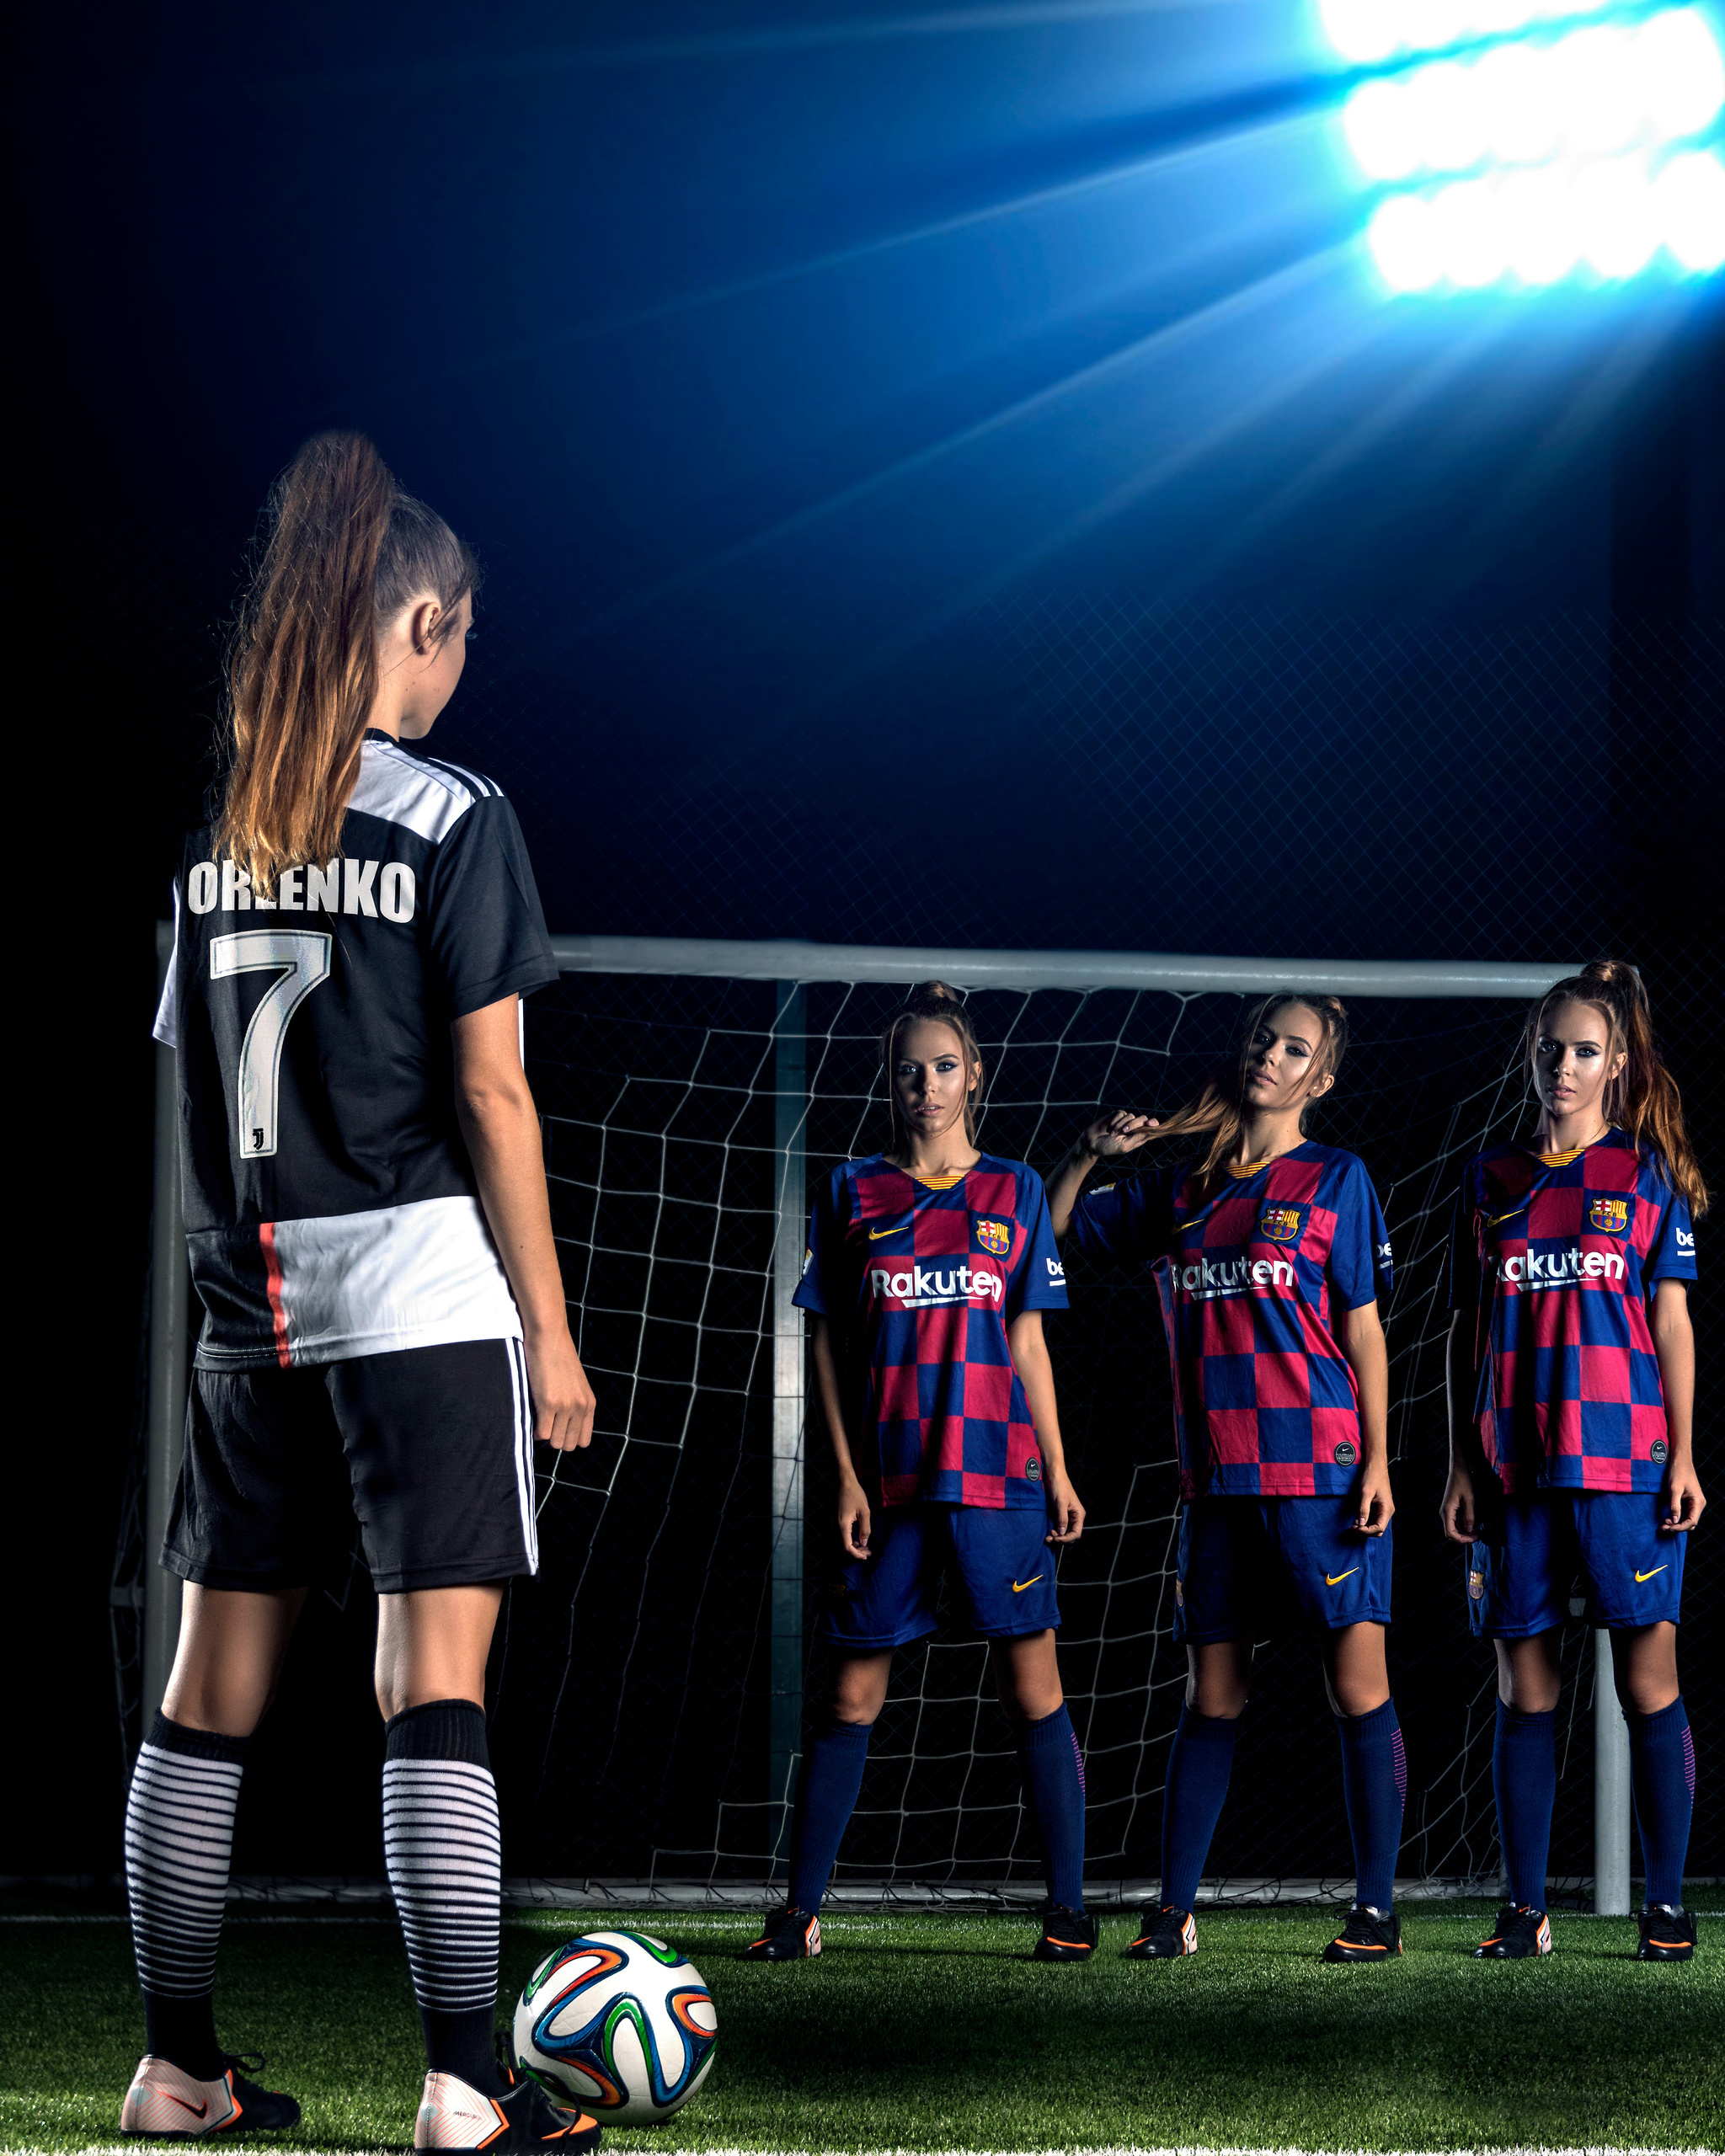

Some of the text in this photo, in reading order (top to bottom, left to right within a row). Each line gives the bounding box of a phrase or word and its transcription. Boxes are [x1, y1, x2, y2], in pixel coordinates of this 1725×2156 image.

[188, 858, 416, 923] ORENKO
[210, 929, 333, 1160] 7
[871, 1265, 1002, 1302] Rakuten
